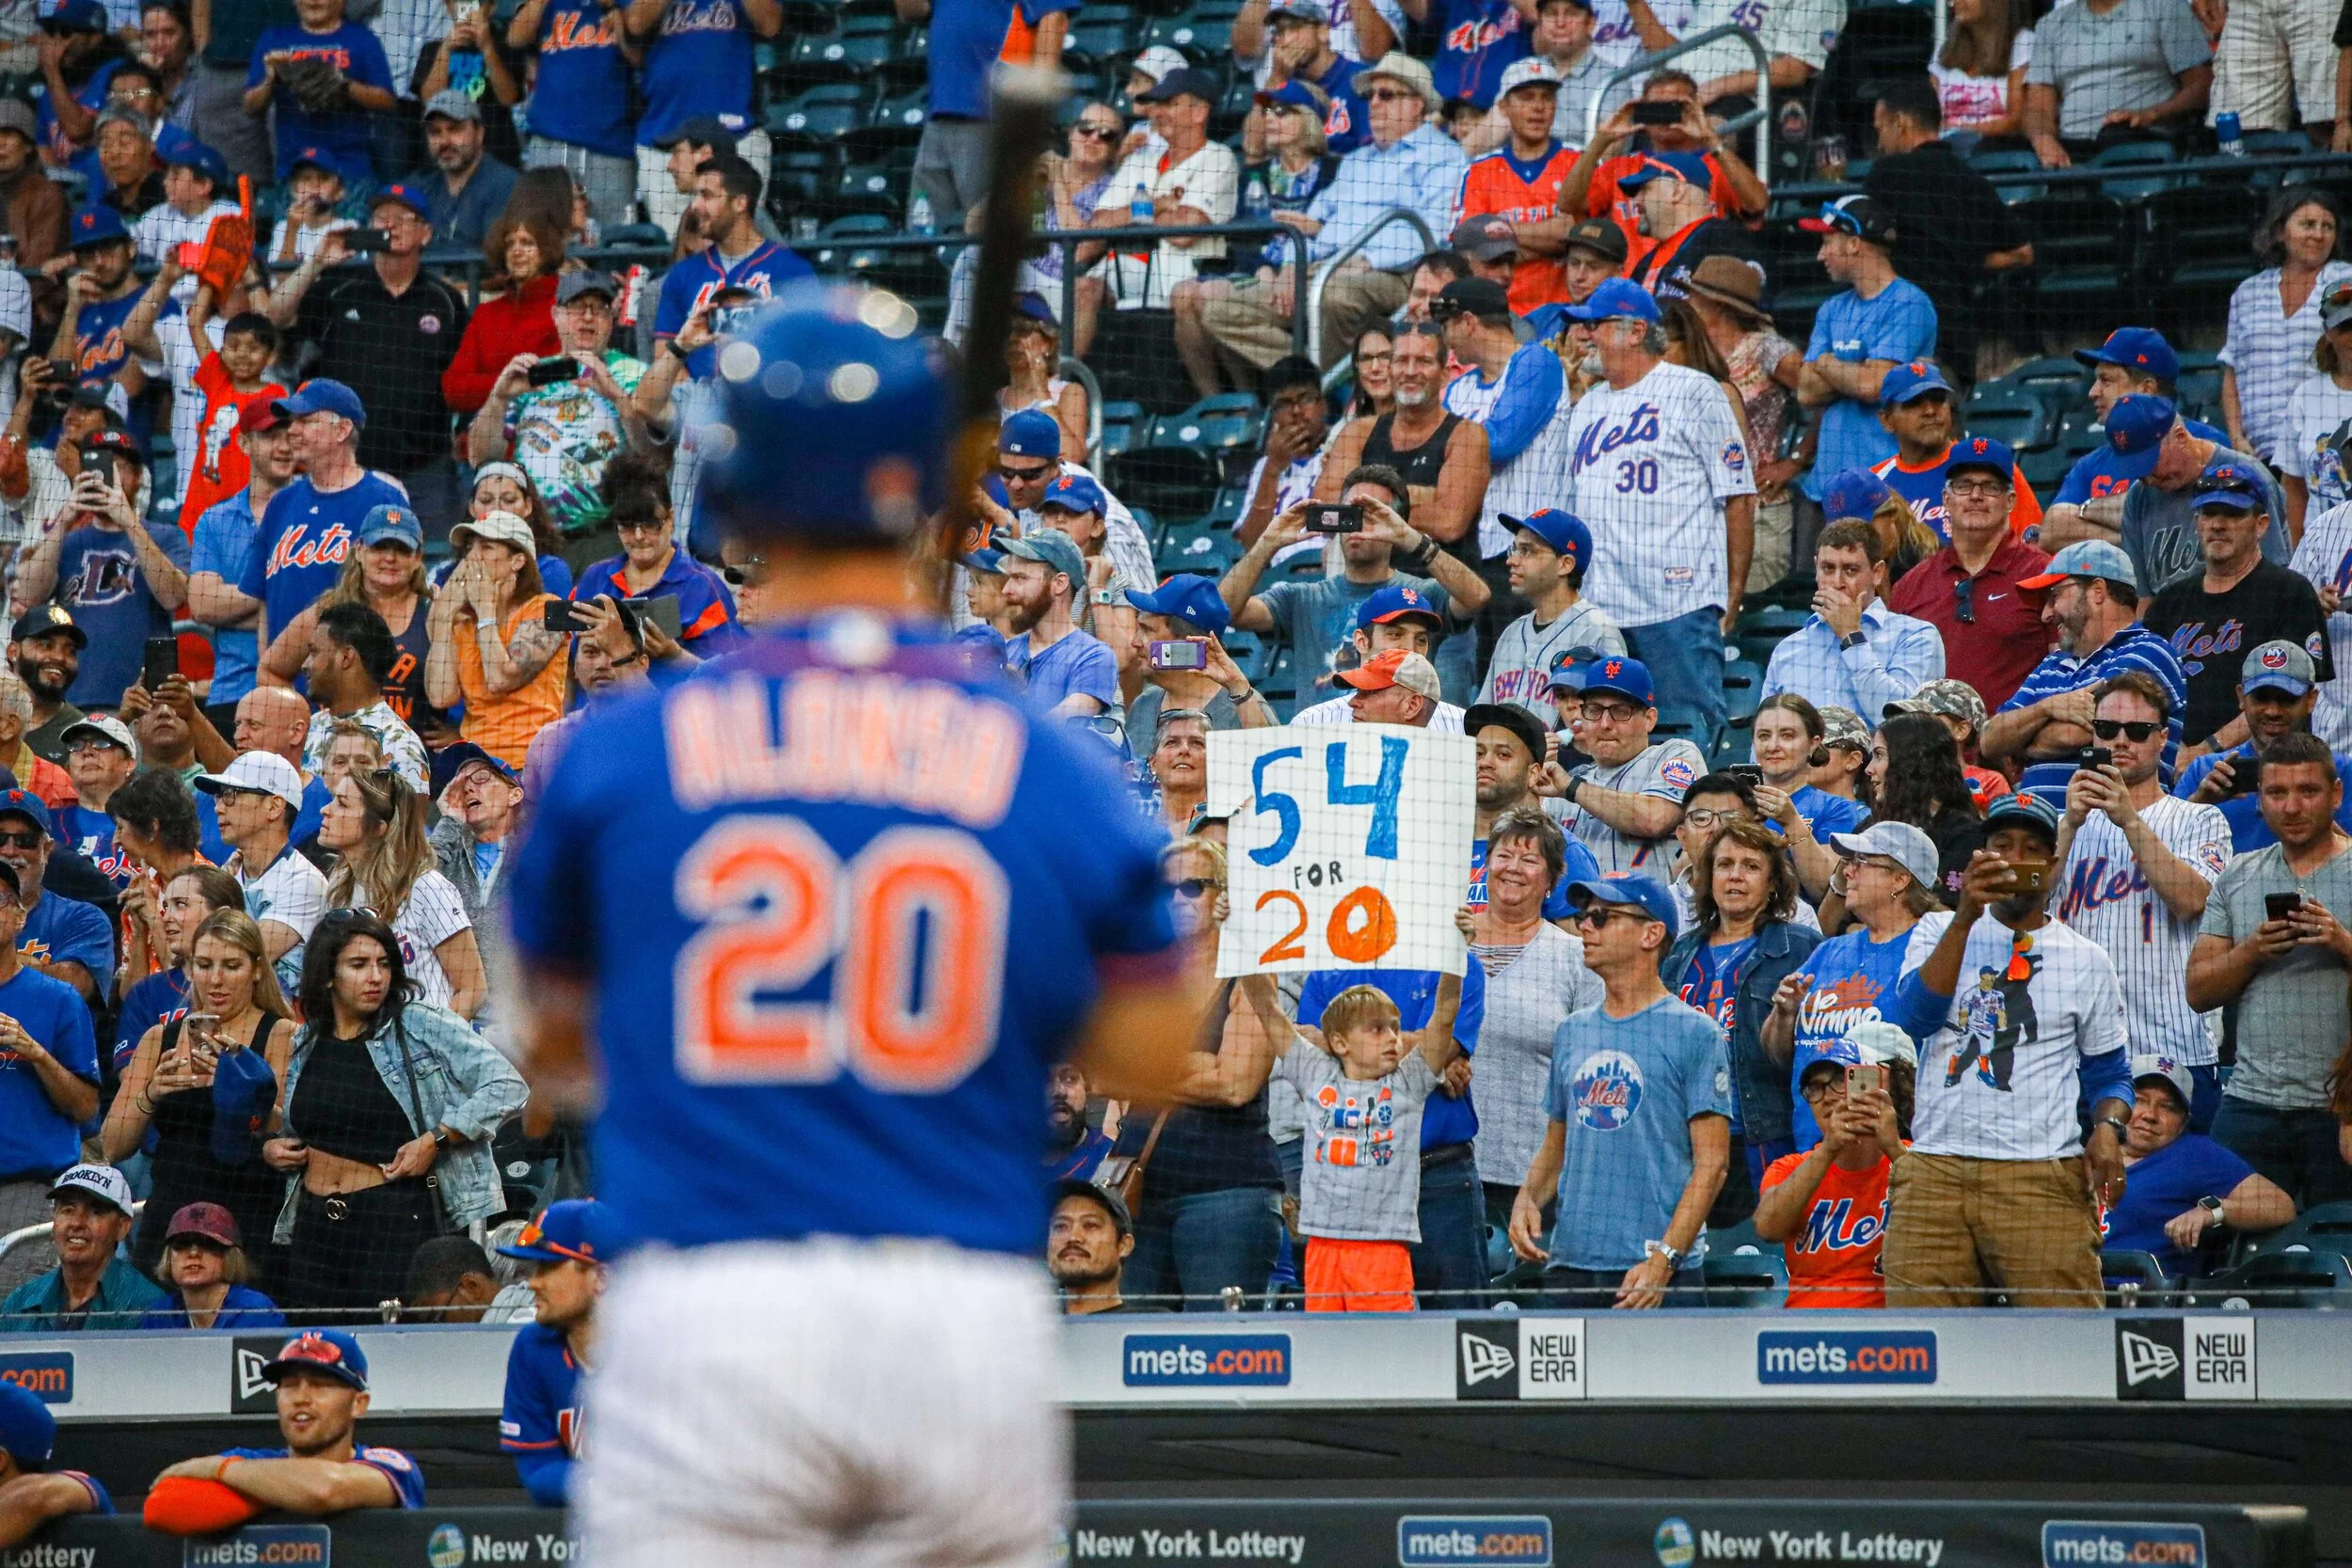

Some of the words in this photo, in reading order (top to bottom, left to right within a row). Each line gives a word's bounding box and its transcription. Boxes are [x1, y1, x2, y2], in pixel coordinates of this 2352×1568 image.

[1572, 403, 1661, 475] Mets
[1615, 459, 1660, 495] 30
[265, 521, 351, 580] Mets
[2171, 618, 2244, 659] Mets
[1248, 735, 1409, 866] 54
[1294, 861, 1343, 889] FOR
[2057, 857, 2151, 924] Met
[1255, 886, 1397, 964] 20
[2140, 901, 2153, 943] 1
[674, 815, 1010, 1095] 20
[1577, 1071, 1627, 1109] Mets
[60, 1169, 112, 1191] BROOKLYN
[1795, 1198, 1889, 1255] Met
[1131, 1343, 1283, 1375] mets.com
[1531, 1334, 1577, 1357] NEW
[1766, 1340, 1929, 1373] mets.com
[2196, 1333, 2246, 1357] NEW
[1531, 1360, 1577, 1383] ERA
[2196, 1359, 2246, 1384] ERA
[193, 1538, 322, 1564] mets.com
[472, 1534, 529, 1561] New
[1076, 1529, 1136, 1558] New
[1141, 1528, 1201, 1558] York
[1208, 1528, 1305, 1565] Lottery
[1408, 1529, 1544, 1557] mets.com
[1700, 1530, 1762, 1560] New
[1769, 1529, 1833, 1560] York
[1840, 1530, 1944, 1567] Lottery
[2053, 1534, 2198, 1565] mets.com
